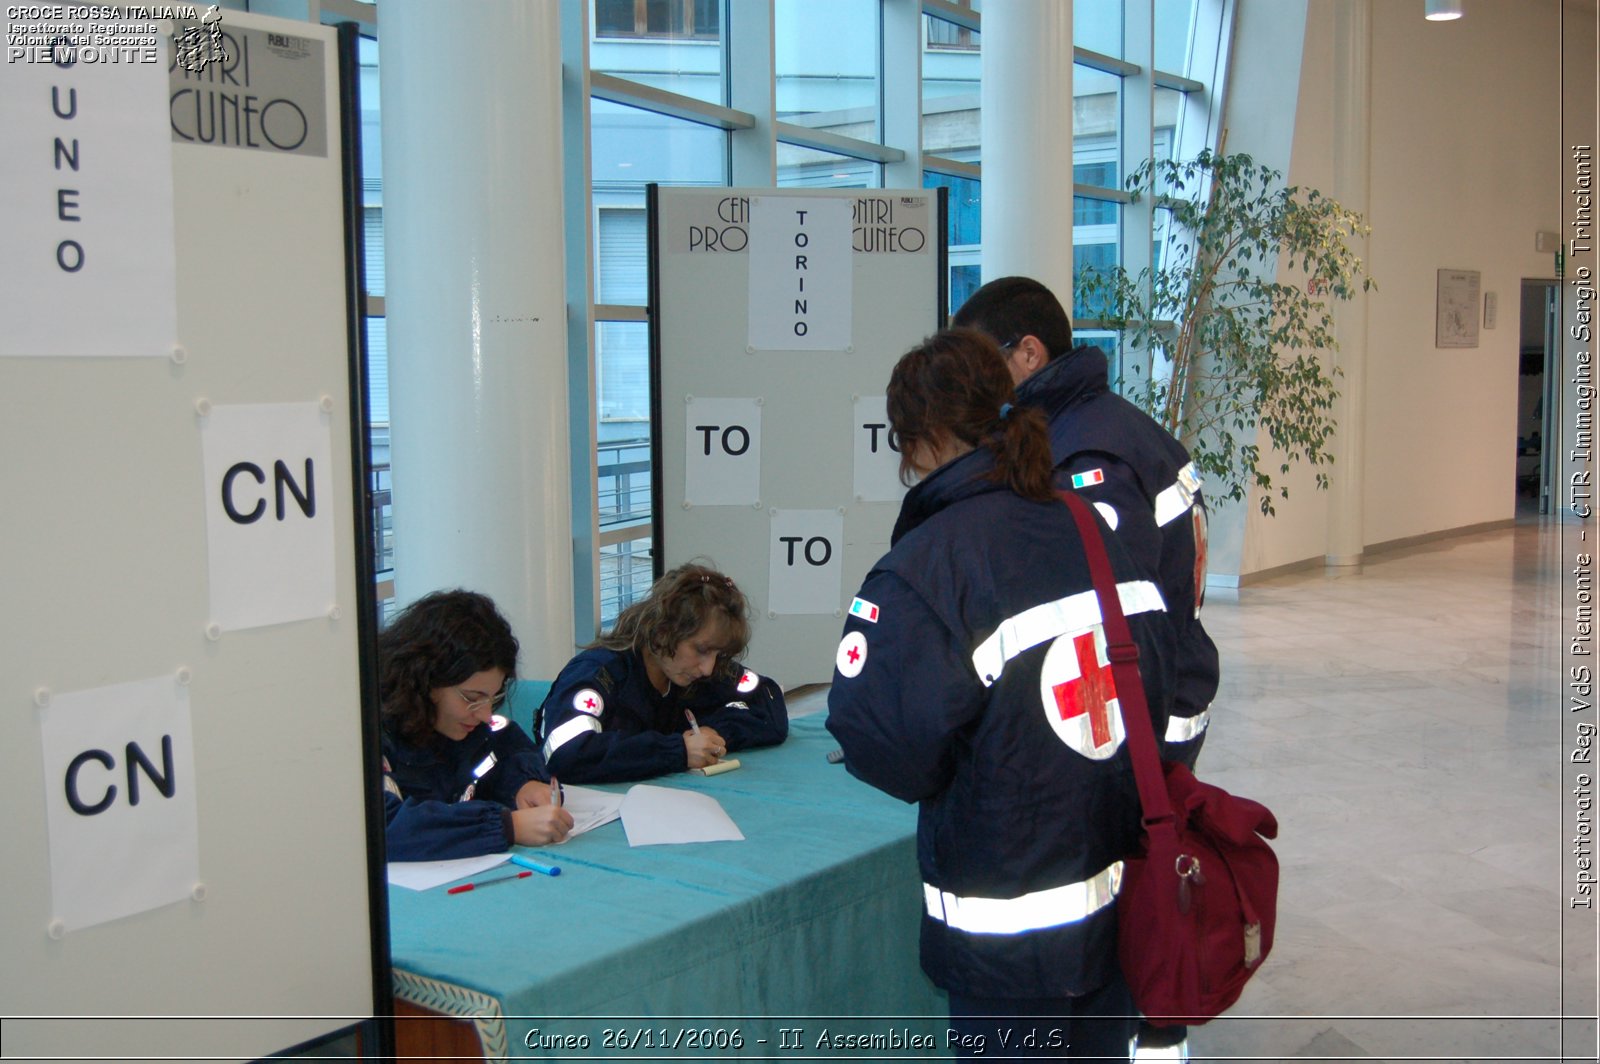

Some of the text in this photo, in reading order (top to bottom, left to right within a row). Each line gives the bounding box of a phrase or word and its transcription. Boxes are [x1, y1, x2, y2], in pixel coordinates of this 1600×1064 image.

[169, 88, 308, 150] CUNEO
[50, 36, 86, 273] CUNEO
[689, 226, 749, 252] PRO
[852, 198, 893, 224] NTRI
[793, 210, 808, 337] TORINO
[696, 425, 750, 456] TO
[221, 457, 316, 525] CN
[779, 536, 832, 567] TO
[64, 734, 175, 817] CN
